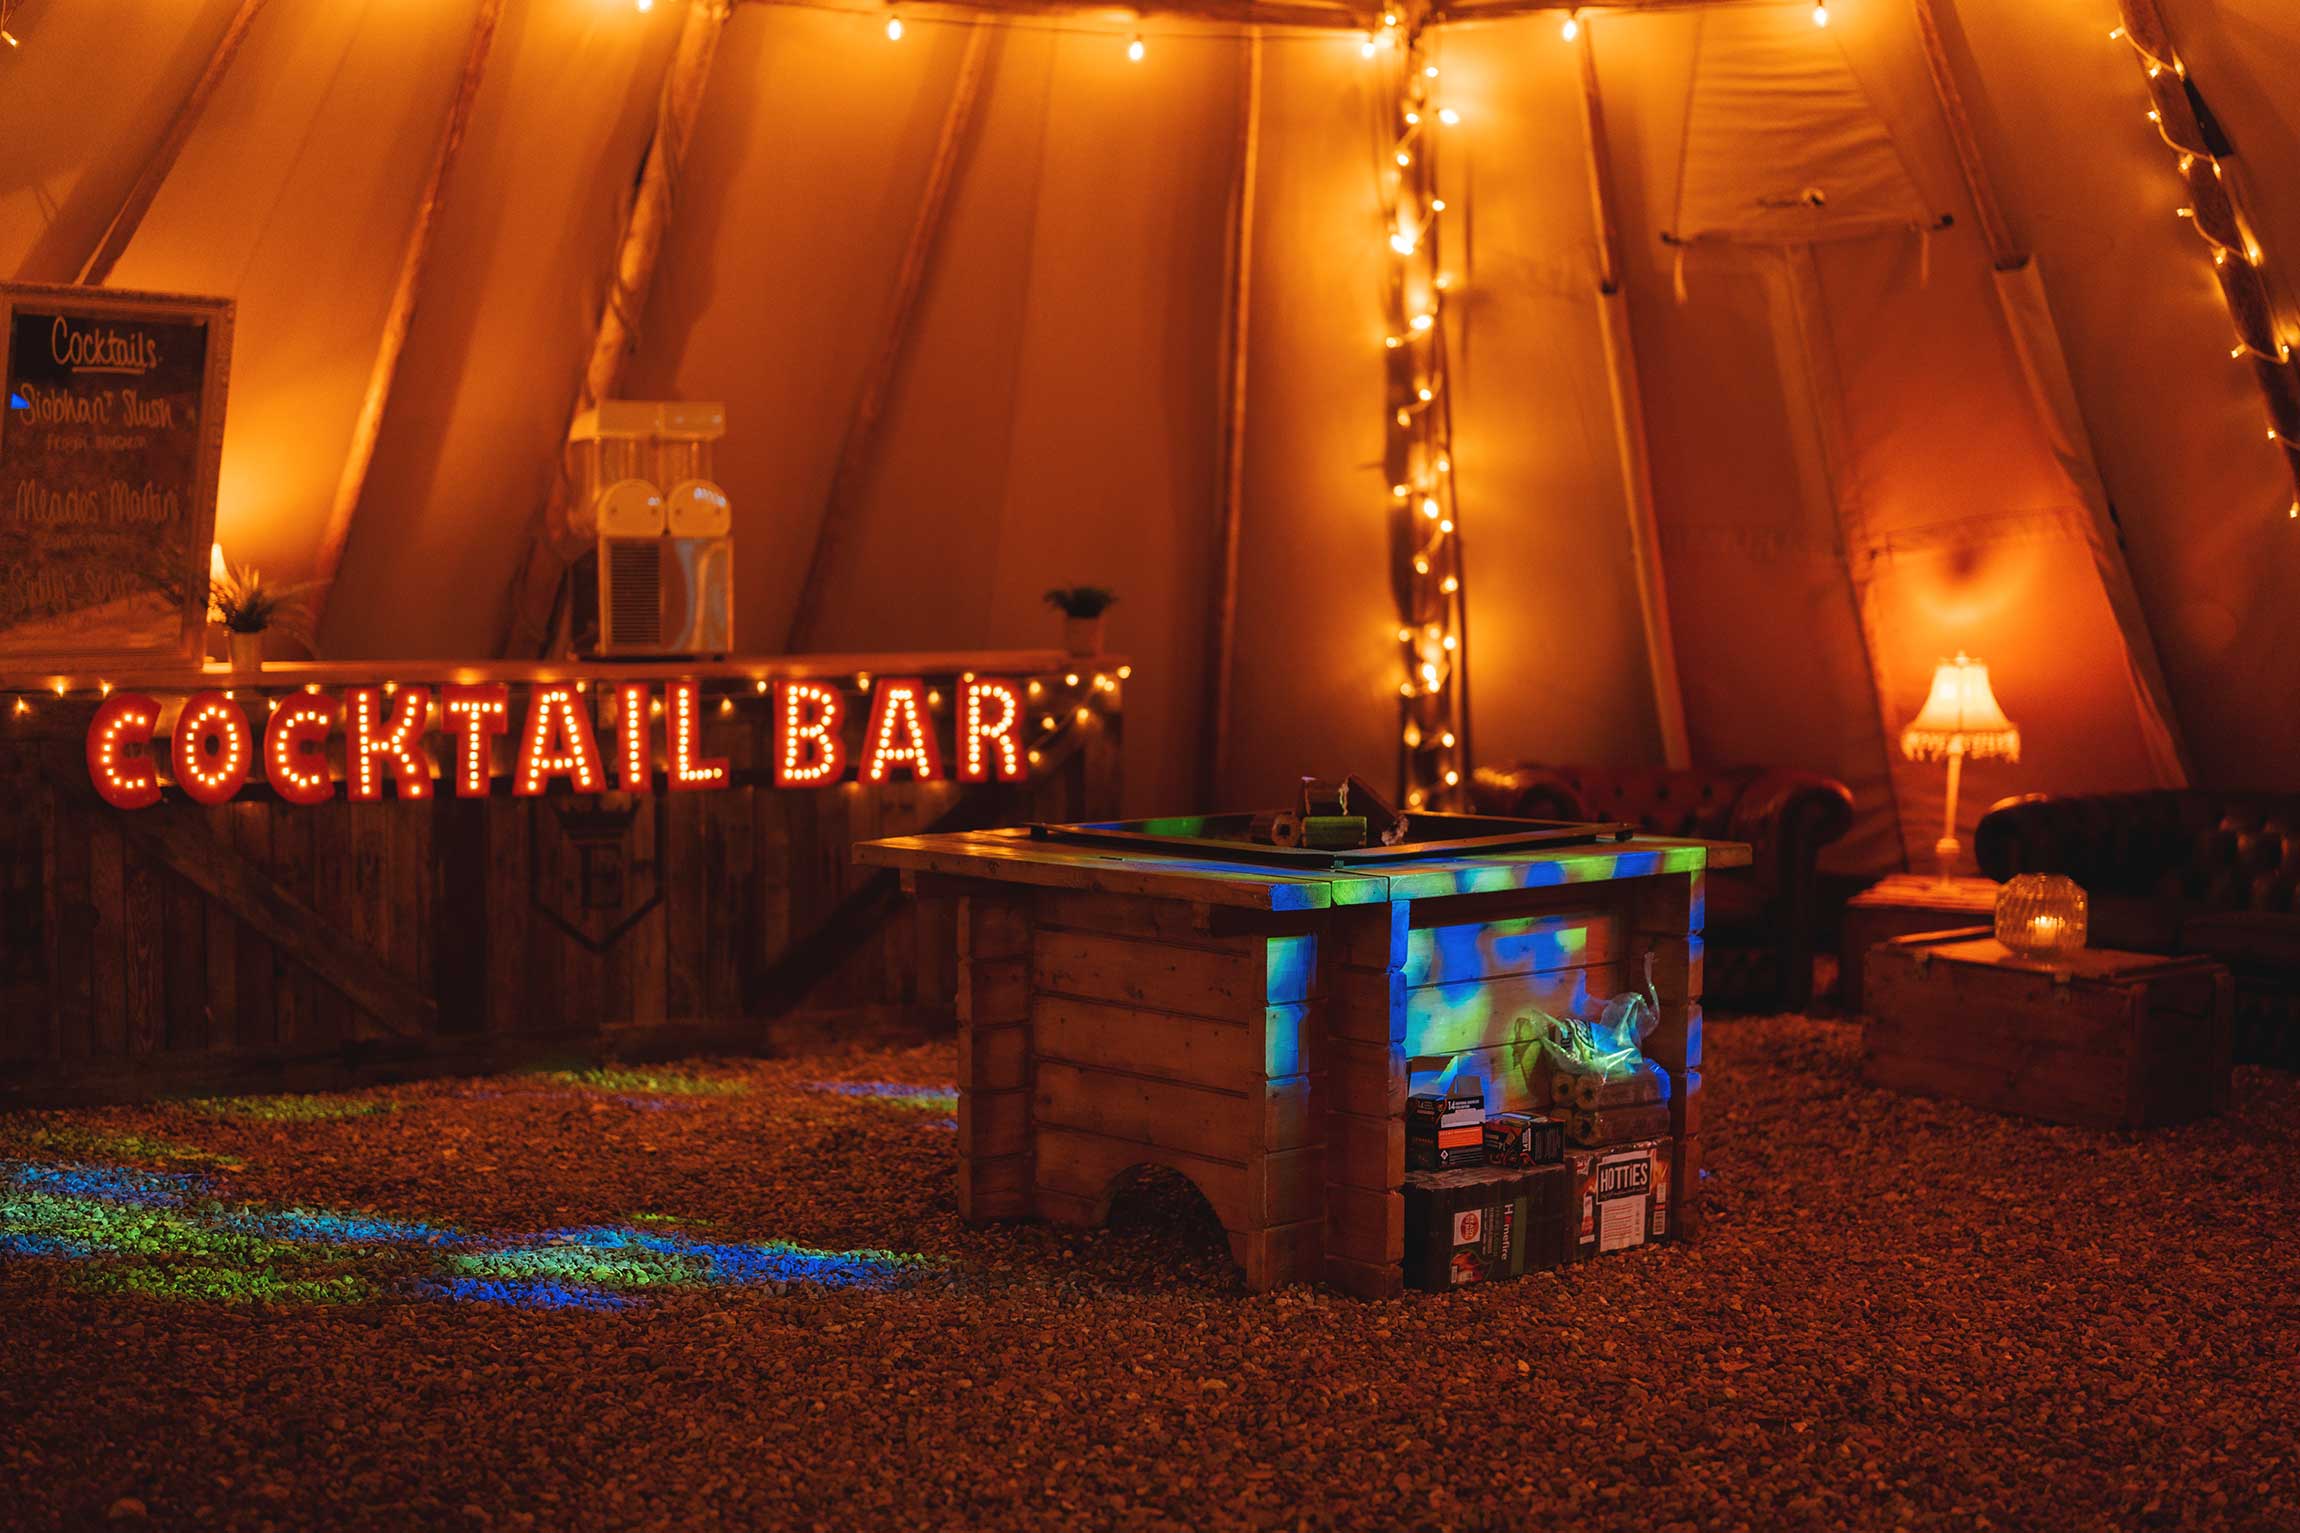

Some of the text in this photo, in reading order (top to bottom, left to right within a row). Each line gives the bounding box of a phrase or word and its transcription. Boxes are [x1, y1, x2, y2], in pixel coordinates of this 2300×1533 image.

[52, 315, 157, 368] Cocktails
[122, 388, 175, 429] Slush
[86, 677, 1029, 809] COCKTAIL BAR
[1448, 1101, 1455, 1110] 14
